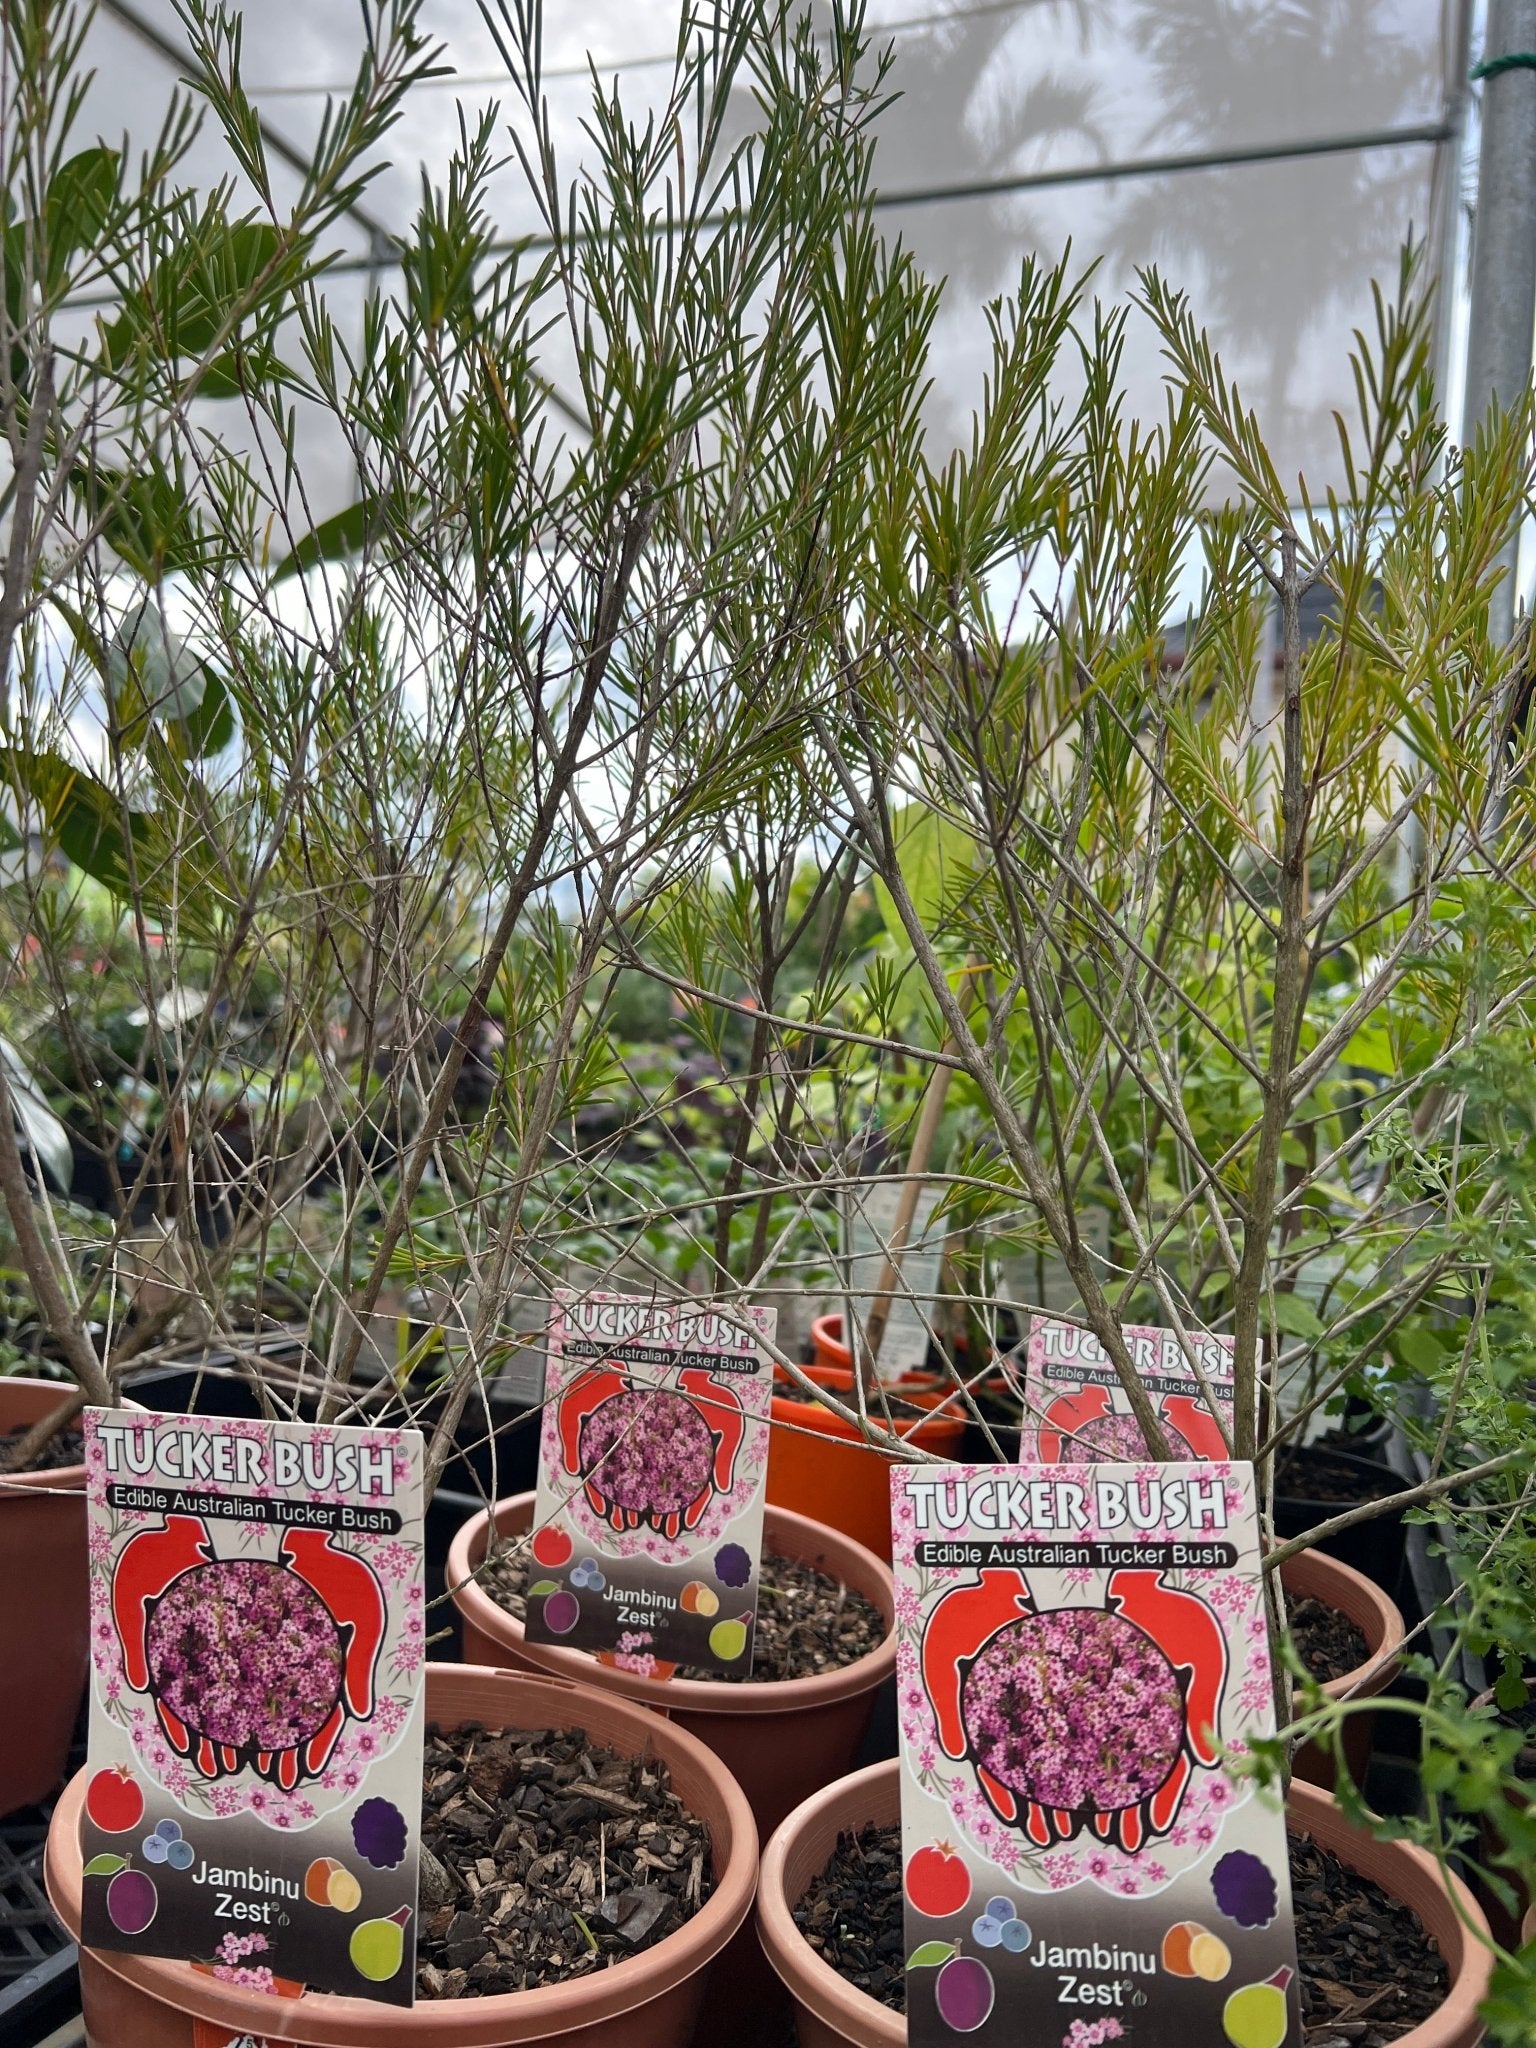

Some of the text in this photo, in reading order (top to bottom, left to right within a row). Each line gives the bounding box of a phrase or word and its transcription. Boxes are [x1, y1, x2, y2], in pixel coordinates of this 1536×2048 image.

[564, 1303, 758, 1349] TUCKER BUSH
[608, 1345, 670, 1363] Australian
[674, 1351, 717, 1367] Tucker
[720, 1356, 753, 1371] Bush
[1046, 1365, 1085, 1381] Edible
[1158, 1378, 1200, 1394] Tucker
[97, 1425, 394, 1496] TUCKER BUSH
[114, 1487, 392, 1530] Edible Australian Tucker Bush
[905, 1480, 1228, 1531] TUCKER BUSH
[923, 1543, 1228, 1565] Edible Australian Tucker Bush
[602, 1584, 677, 1611] Jambinu
[616, 1605, 656, 1627] Zest
[192, 1860, 300, 1900] Jambinu
[214, 1893, 271, 1924] Zest
[1029, 1939, 1157, 1975] Jambinu
[1057, 1974, 1124, 2007] Zest
